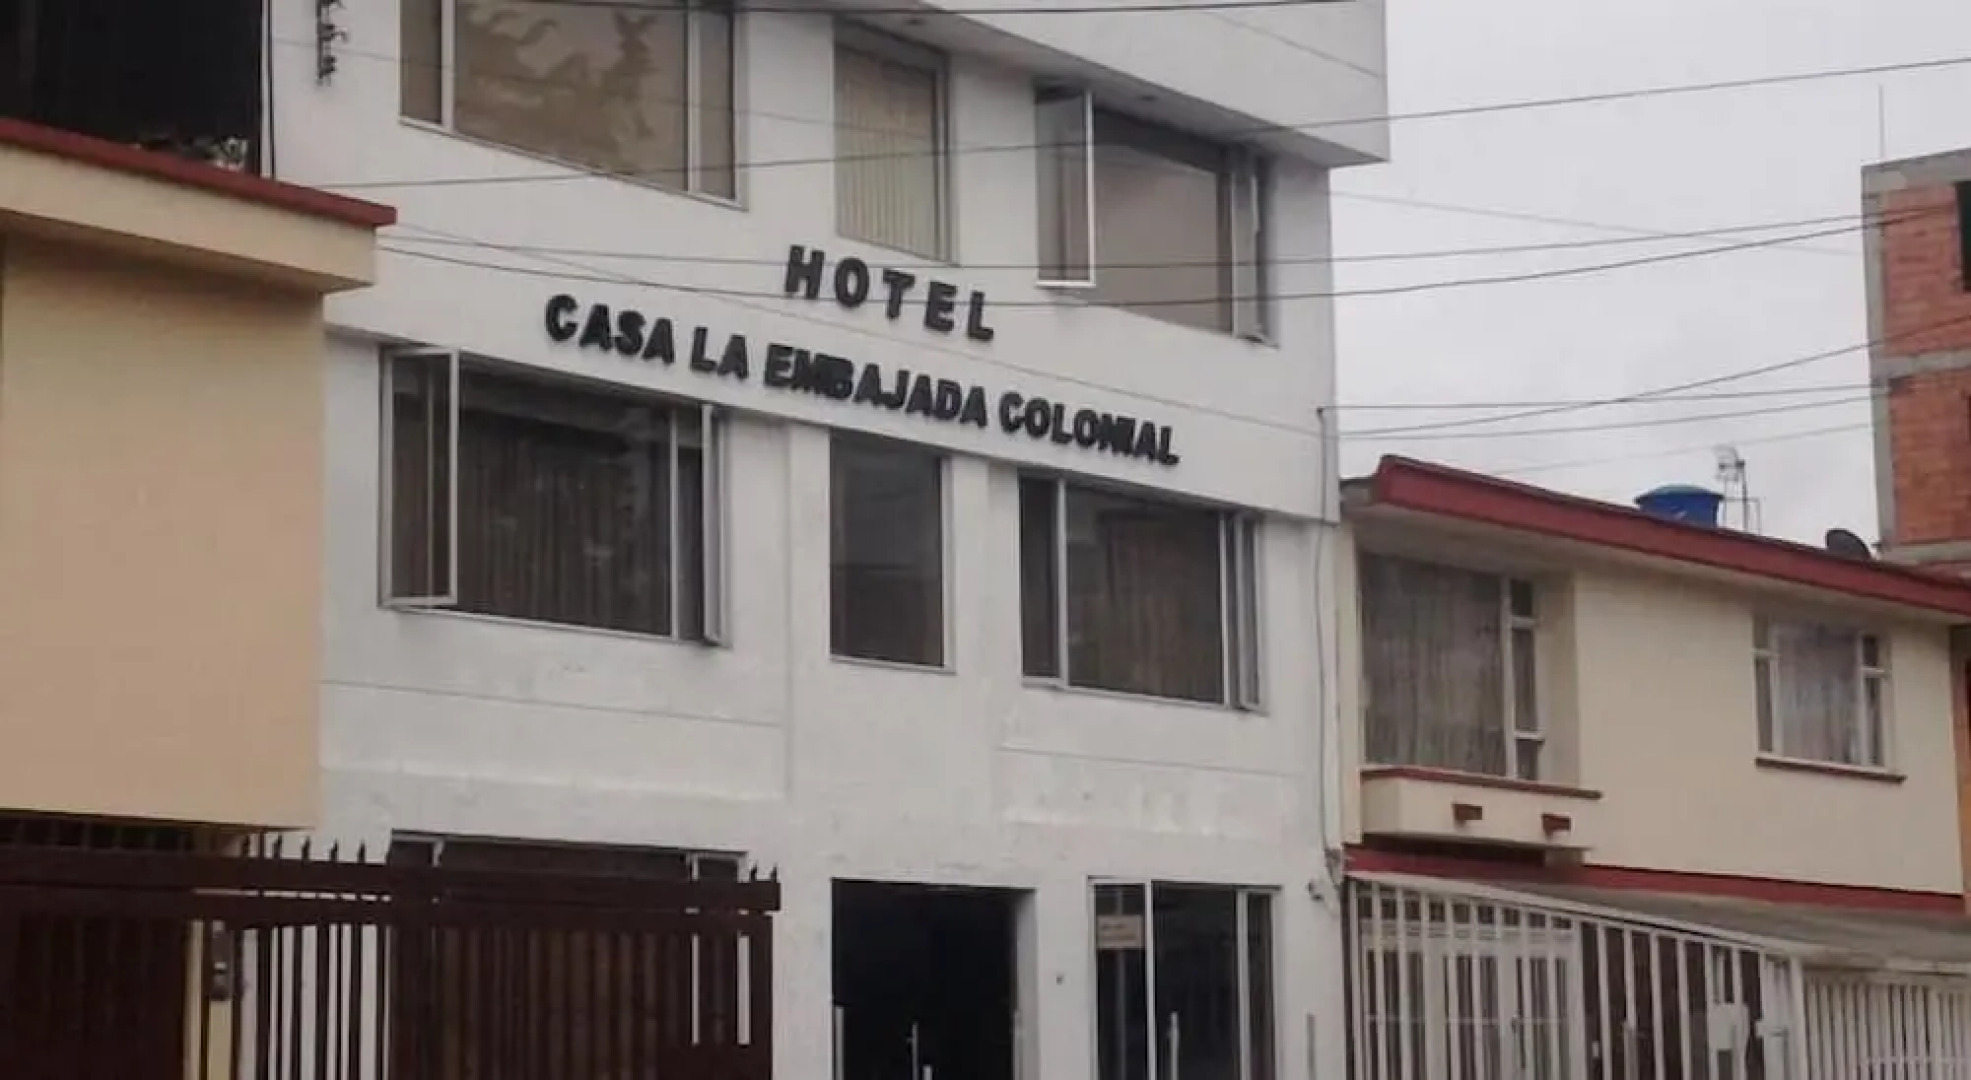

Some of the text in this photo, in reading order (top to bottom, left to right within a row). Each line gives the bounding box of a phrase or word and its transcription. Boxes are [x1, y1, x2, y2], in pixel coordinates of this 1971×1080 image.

[784, 245, 994, 342] HOTEL
[545, 294, 1180, 466] CASA LA EMBAJADA COLONIAL
